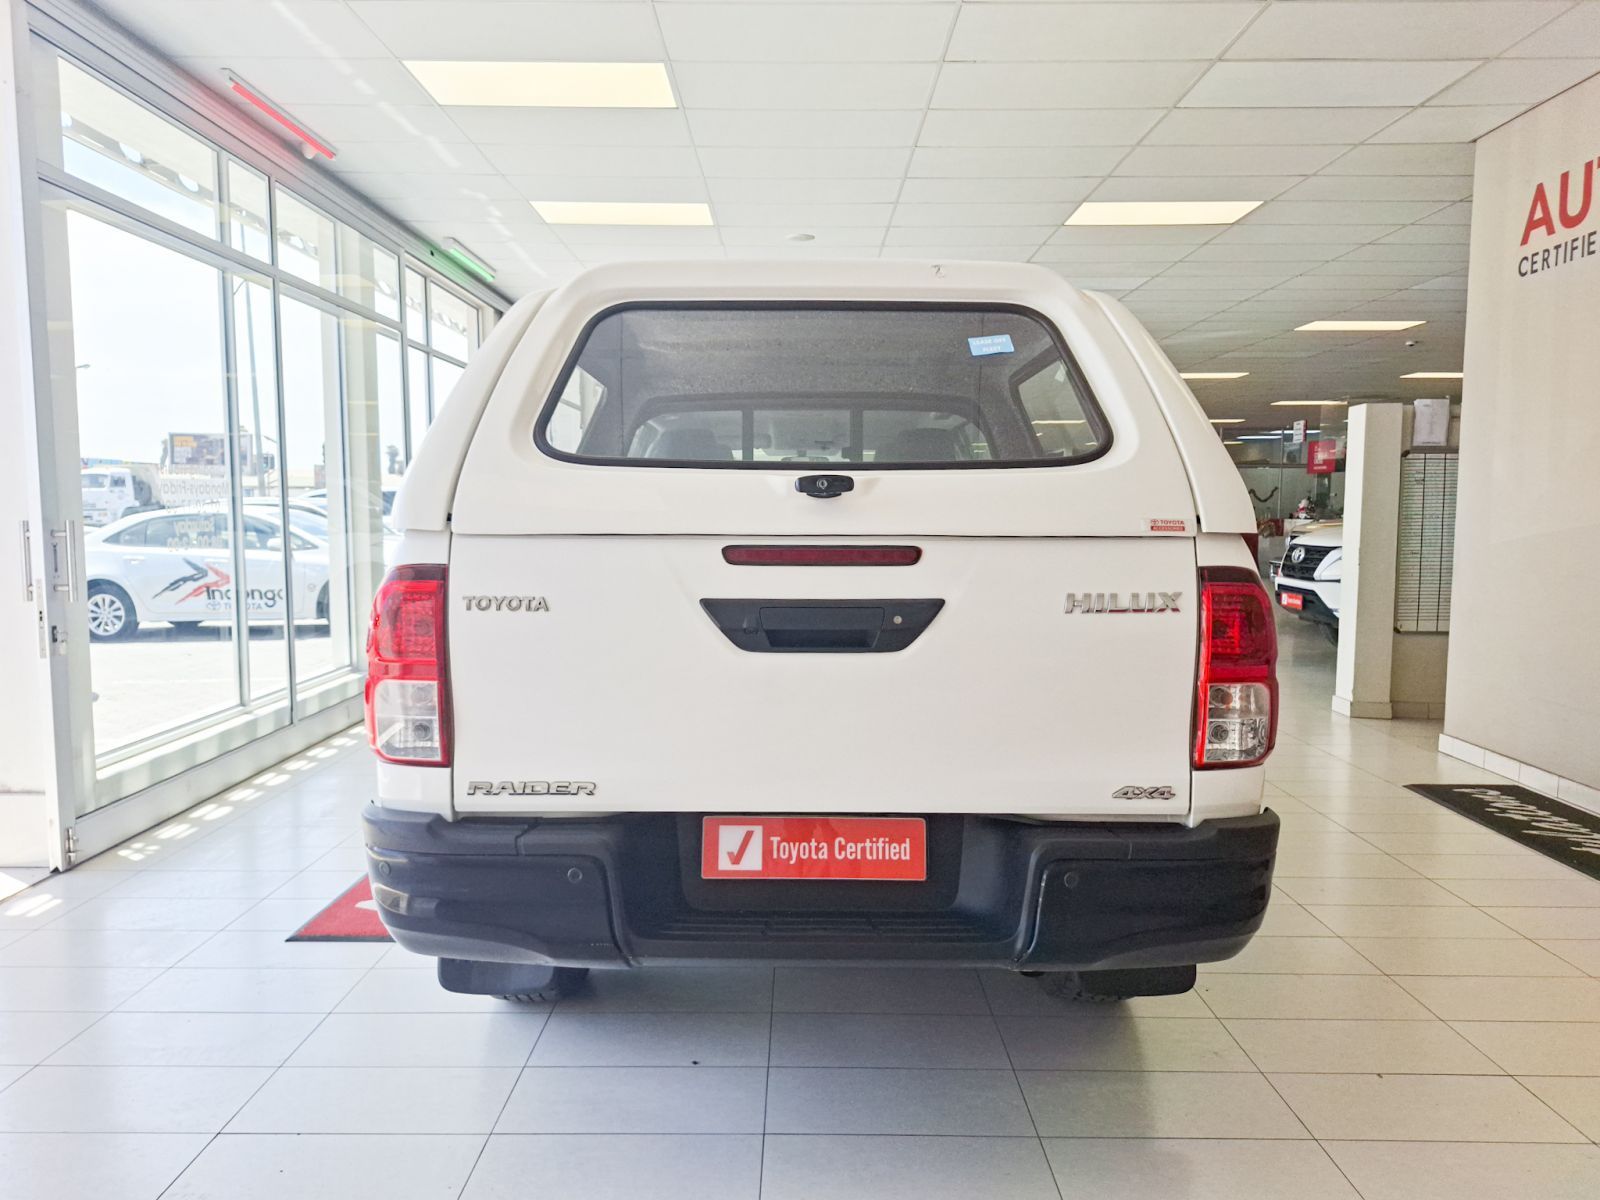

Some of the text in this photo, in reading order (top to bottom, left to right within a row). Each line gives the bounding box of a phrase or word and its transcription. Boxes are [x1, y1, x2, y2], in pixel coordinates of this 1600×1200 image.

[1519, 156, 1600, 246] AU
[1518, 231, 1600, 278] CERTIFIE
[206, 586, 283, 608] Inng
[224, 602, 263, 611] TOTA
[462, 595, 550, 612] TOYOTA
[1064, 592, 1183, 614] HILUX
[466, 780, 597, 796] RAIDER
[770, 836, 911, 864] Toyota Certified
